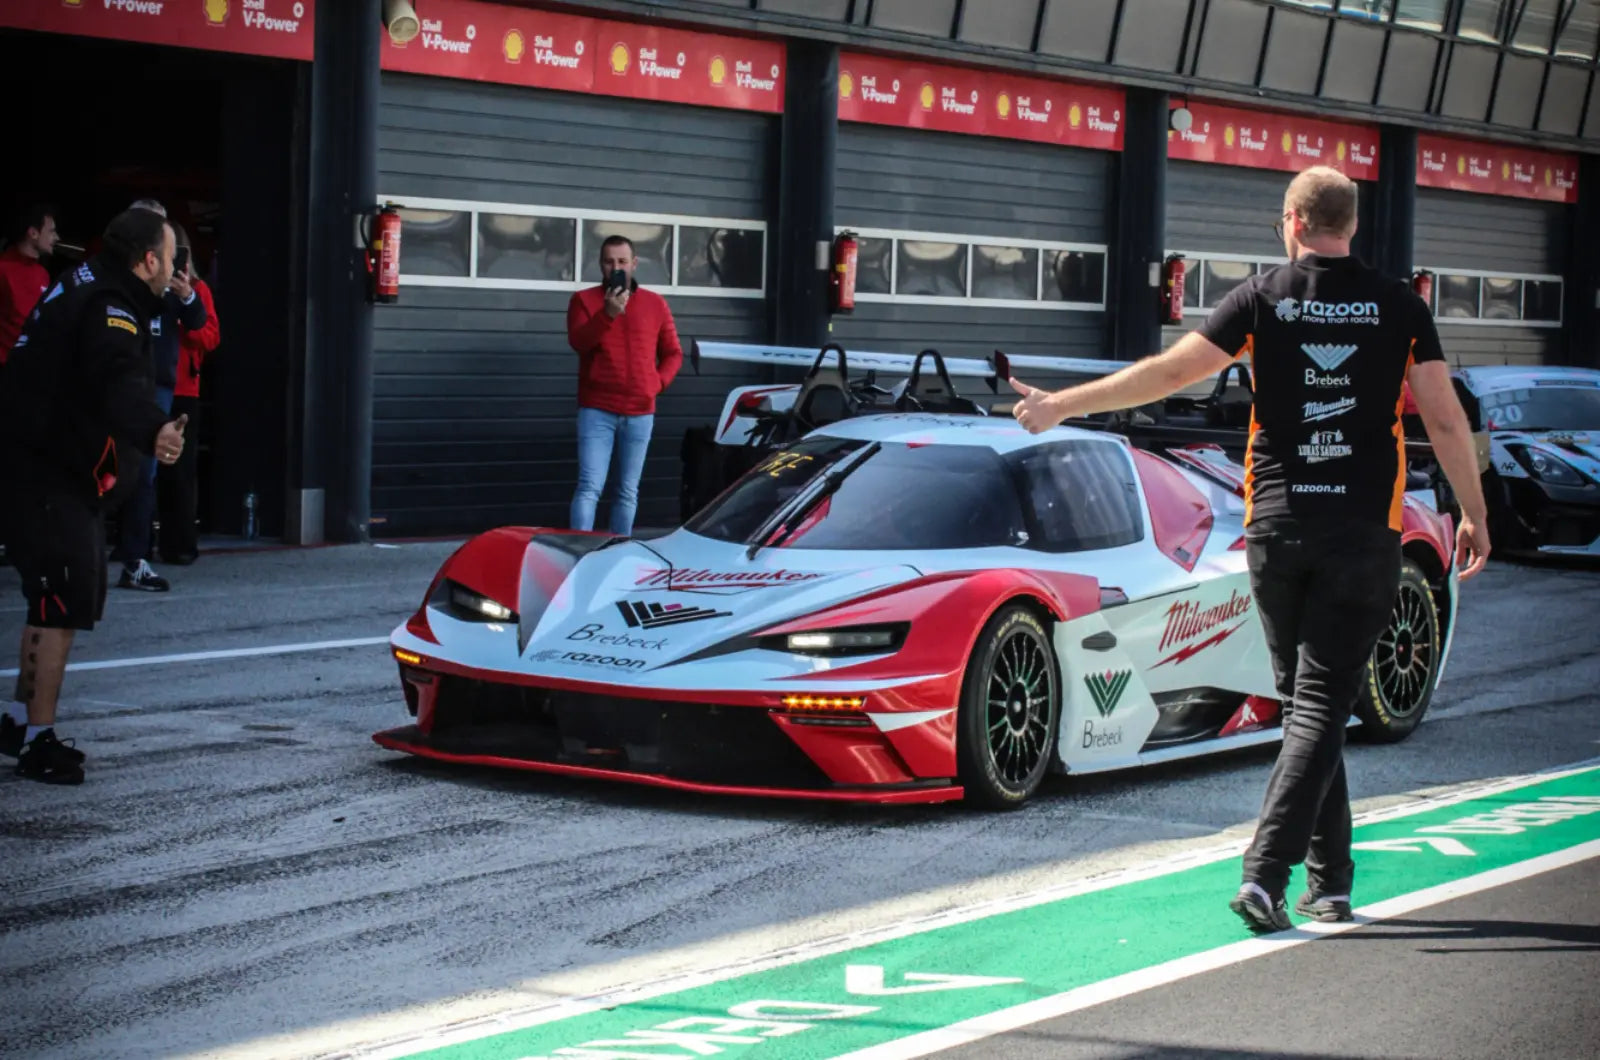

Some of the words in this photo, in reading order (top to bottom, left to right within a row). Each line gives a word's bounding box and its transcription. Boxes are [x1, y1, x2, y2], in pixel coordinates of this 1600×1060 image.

[243, 10, 299, 32] V-Power
[422, 19, 442, 32] Shell
[422, 33, 471, 54] V-Power
[534, 35, 552, 48] Shell
[534, 49, 579, 68] V-Power
[639, 47, 657, 60] Shell
[639, 61, 682, 79] V-Power
[735, 73, 775, 91] V-Power
[861, 87, 897, 104] V-Power
[942, 98, 975, 114] V-Power
[1303, 300, 1379, 317] razoon
[1302, 315, 1325, 324] more
[1328, 315, 1348, 324] than
[1350, 317, 1379, 325] racing
[1305, 368, 1351, 386] Brebeck
[1292, 484, 1346, 494] razoon.at
[634, 567, 820, 587] Milwaukee
[1159, 589, 1251, 653] Milwaukee
[565, 623, 669, 651] Brebeck
[561, 651, 647, 669] razoon
[1082, 720, 1122, 749] Brebeck
